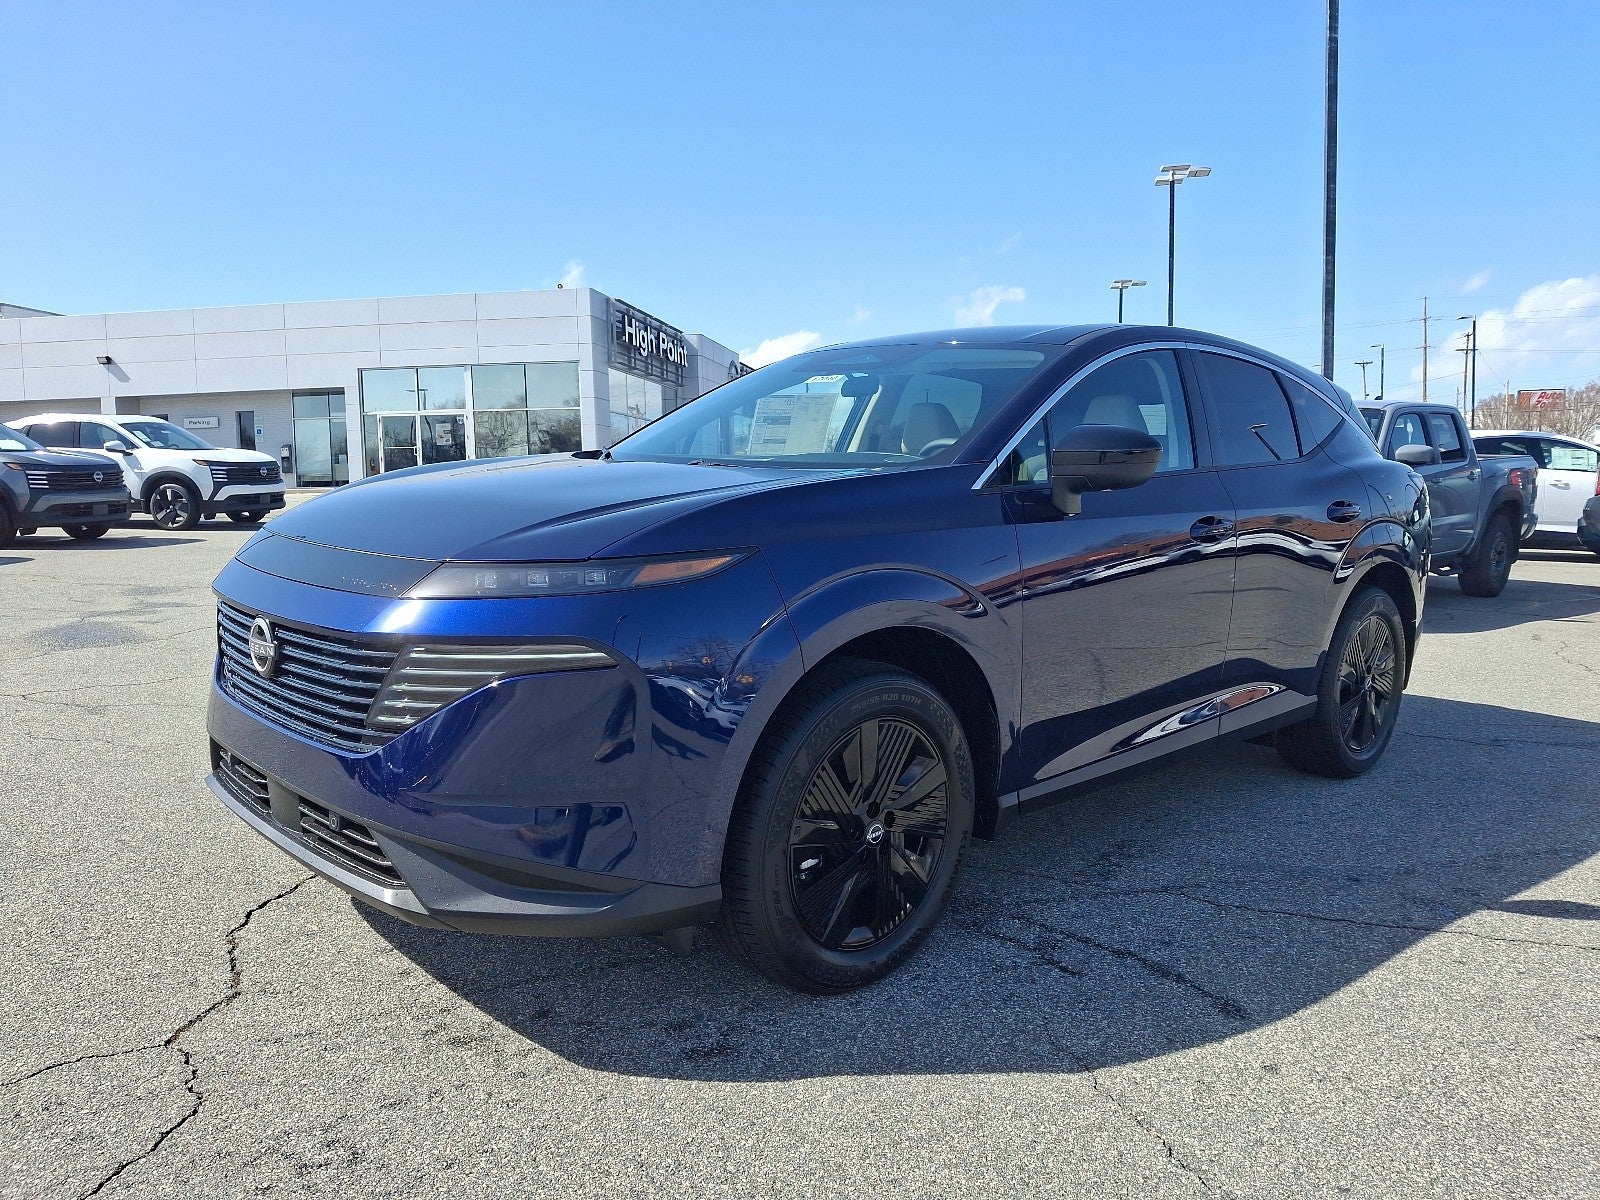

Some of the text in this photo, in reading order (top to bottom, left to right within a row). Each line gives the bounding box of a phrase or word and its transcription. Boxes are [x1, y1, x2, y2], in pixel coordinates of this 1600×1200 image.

[625, 315, 688, 367] High Point
[882, 693, 899, 701] R20
[901, 694, 922, 706] 107H
